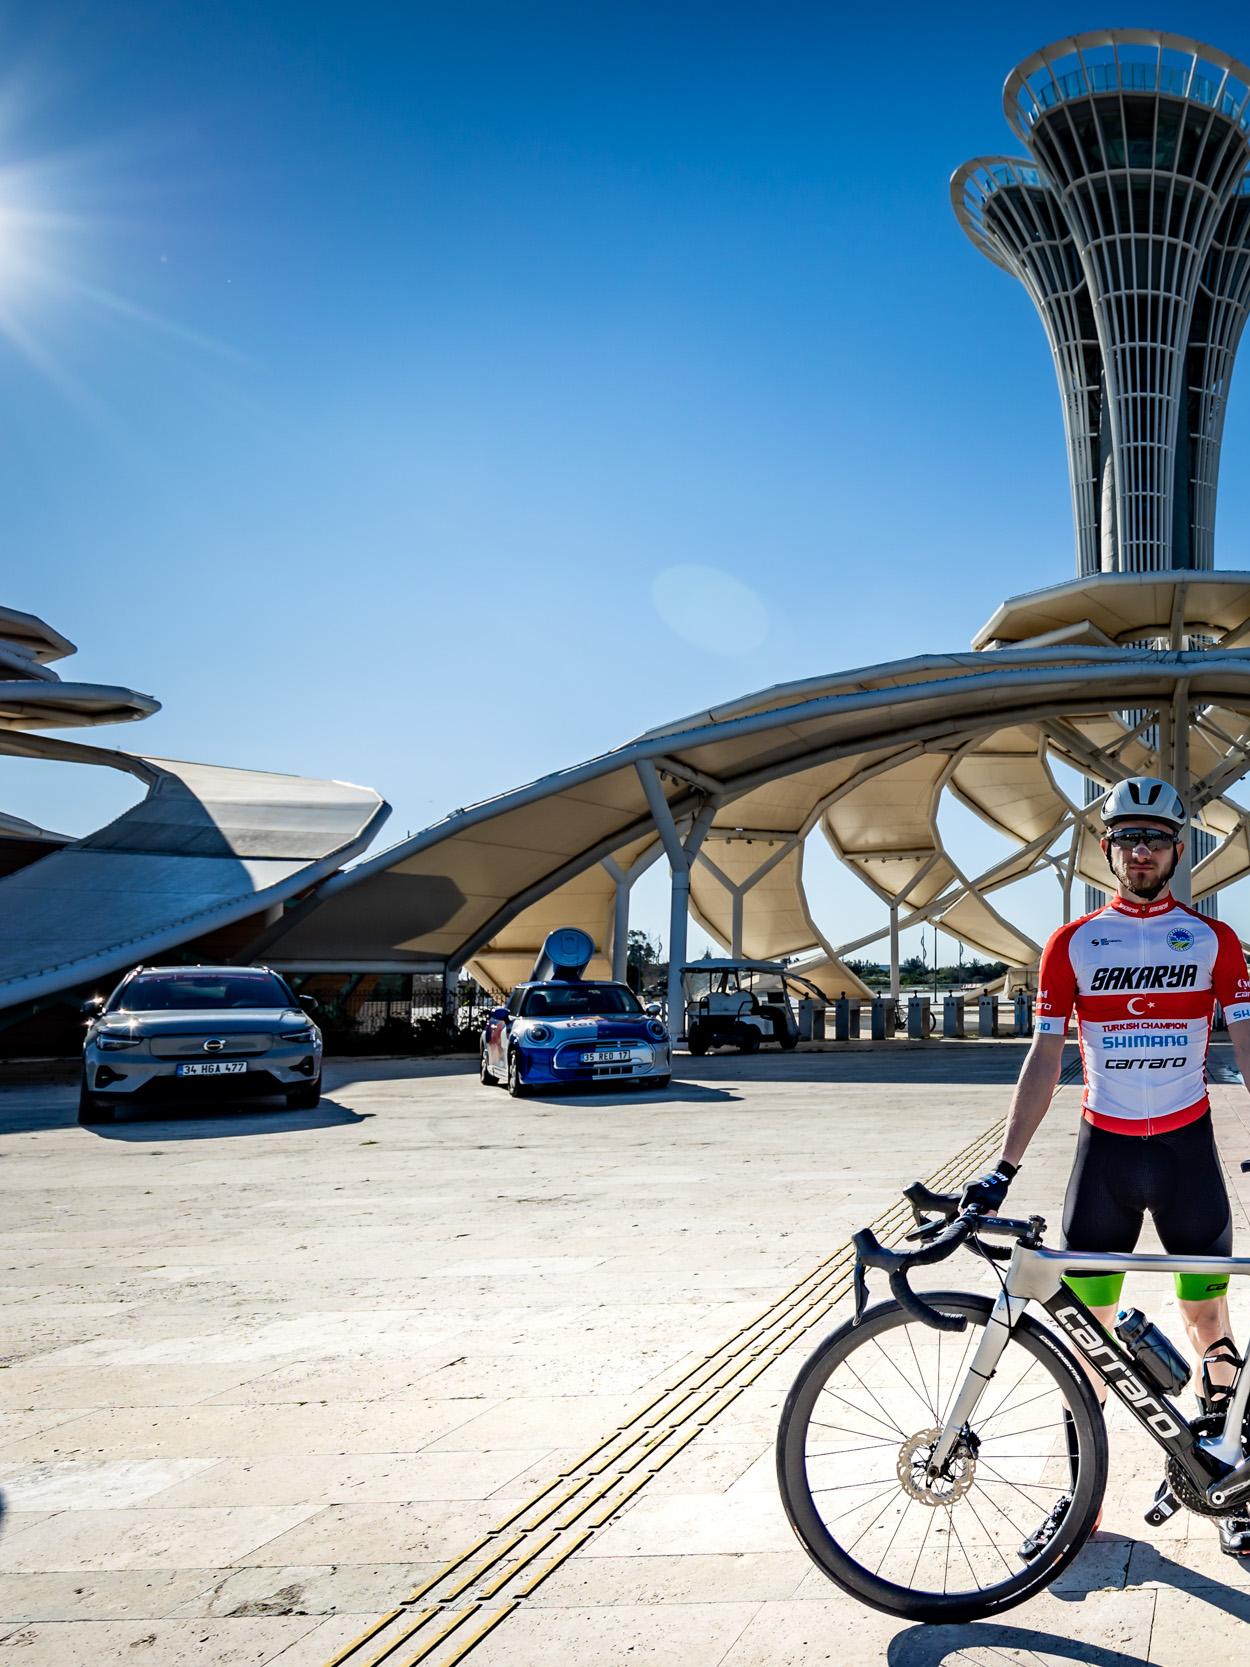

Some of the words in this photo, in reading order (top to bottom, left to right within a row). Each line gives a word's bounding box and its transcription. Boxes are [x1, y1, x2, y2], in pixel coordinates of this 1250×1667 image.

[1091, 965, 1198, 991] SAKARYA
[1102, 1023, 1140, 1033] TURKISH
[1141, 1022, 1188, 1031] CHAMPION
[1102, 1034, 1188, 1049] SHIMANO
[599, 1052, 614, 1060] RED
[184, 1065, 197, 1075] 34
[201, 1065, 220, 1074] HGA
[225, 1063, 244, 1072] 477
[1105, 1057, 1187, 1070] carraro
[1055, 1306, 1181, 1439] carraro
